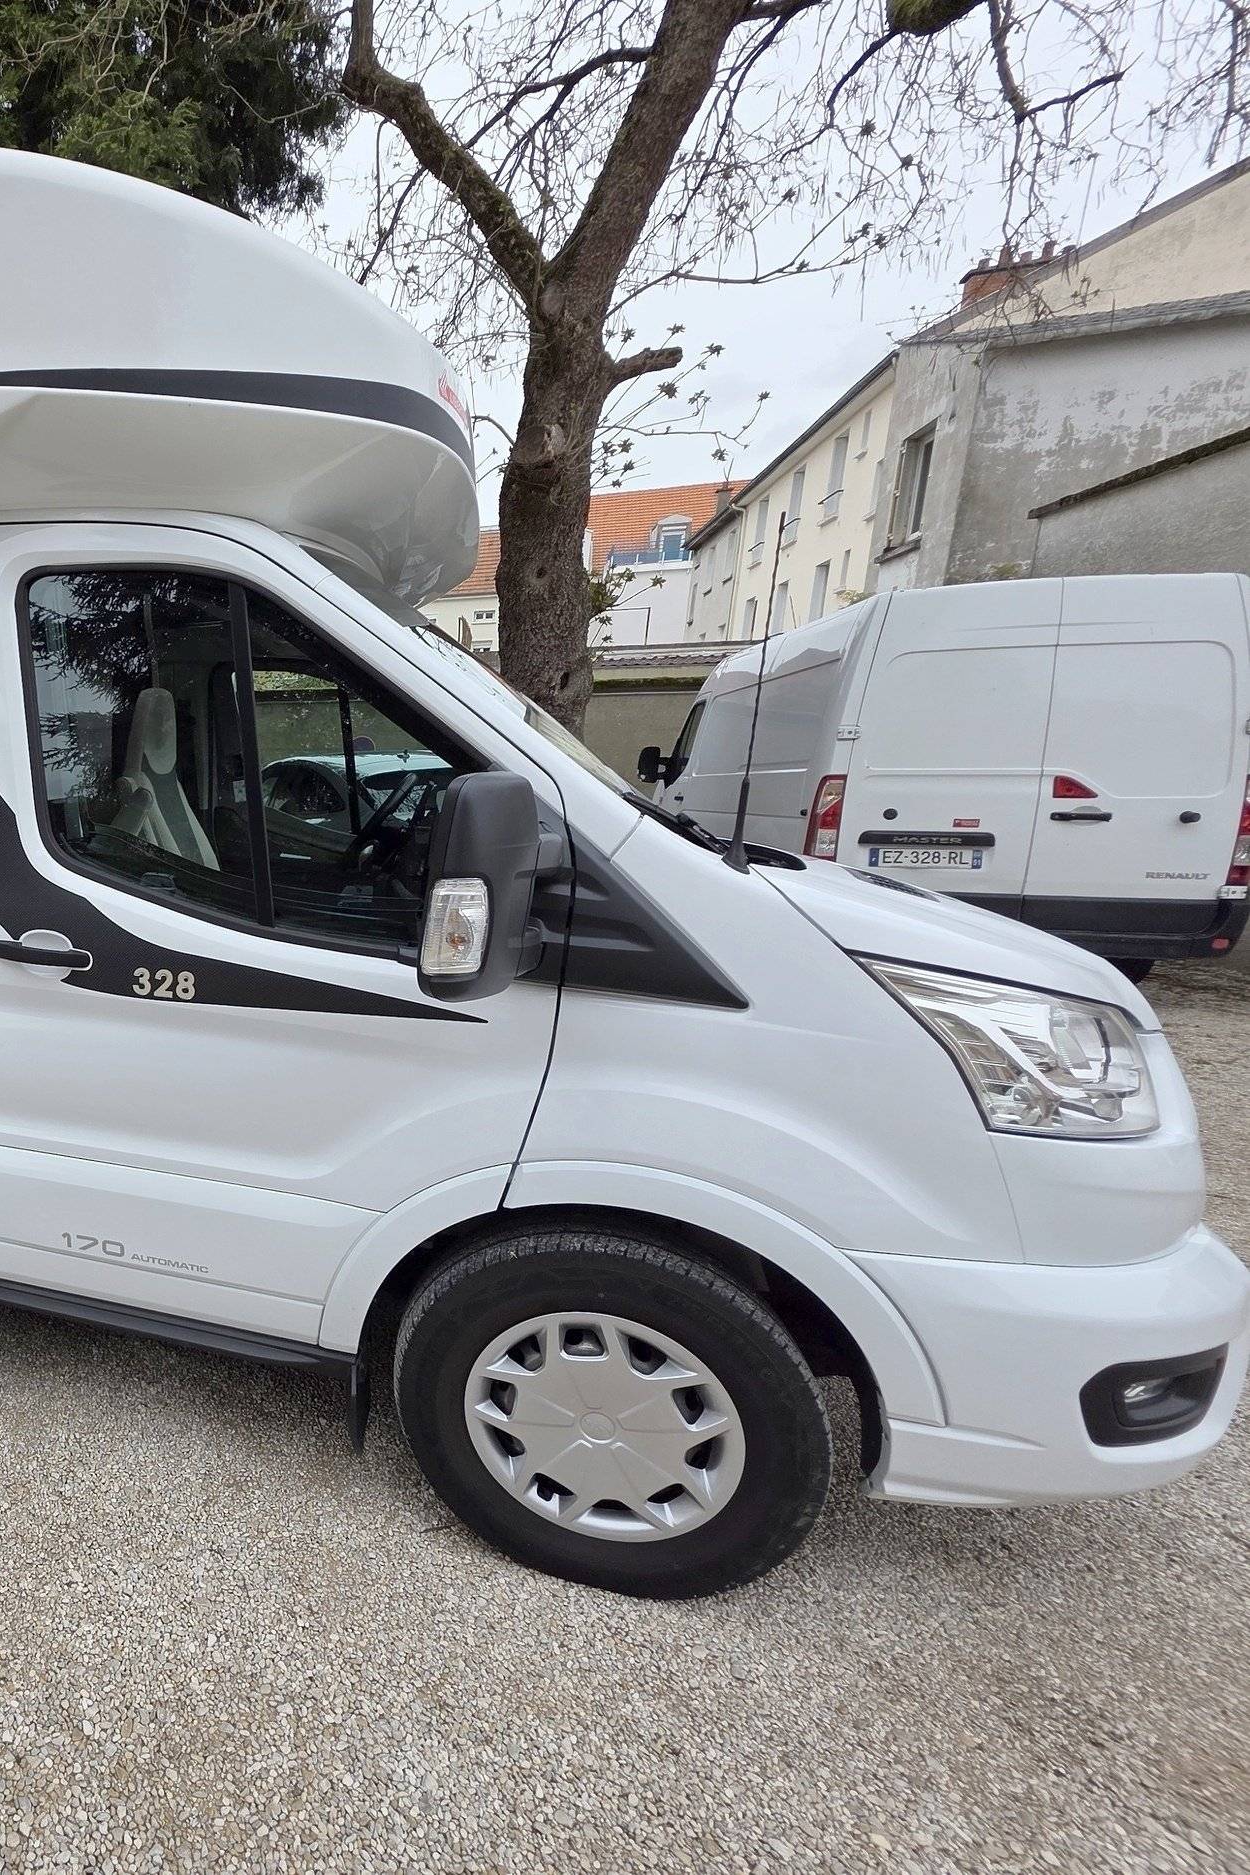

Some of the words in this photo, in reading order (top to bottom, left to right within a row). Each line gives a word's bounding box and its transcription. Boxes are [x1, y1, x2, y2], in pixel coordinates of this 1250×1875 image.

[893, 836, 963, 845] MASTER
[882, 850, 969, 865] EZ-328-RL
[1145, 871, 1211, 880] RENAULT
[132, 967, 196, 1000] 328
[61, 1231, 125, 1258] 170
[131, 1253, 209, 1274] AUTOMATIC
